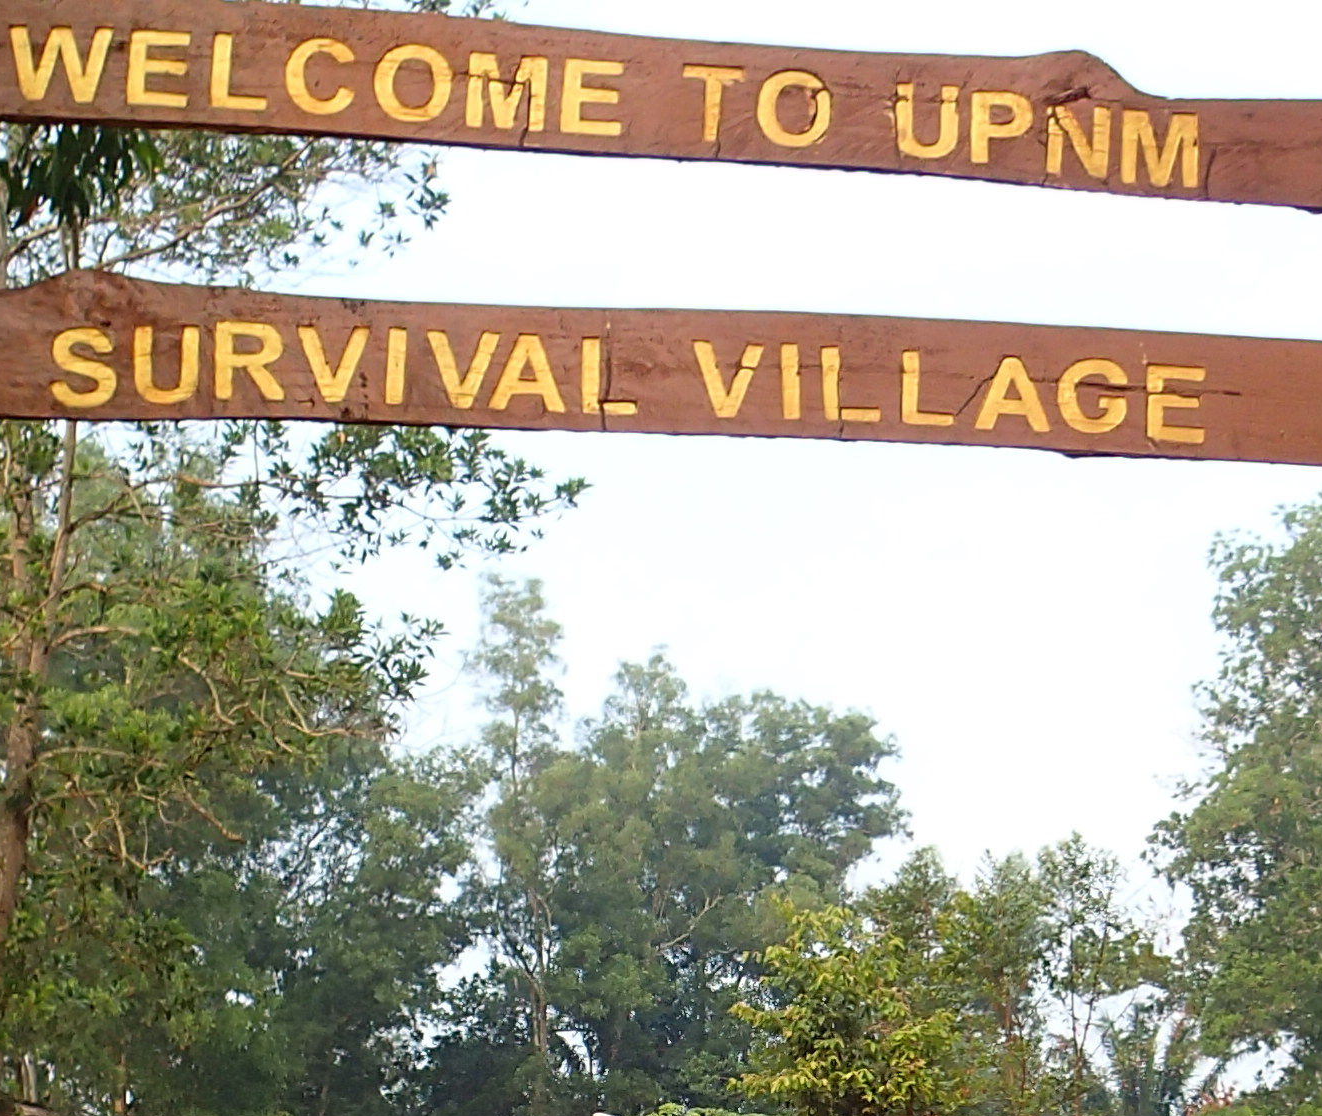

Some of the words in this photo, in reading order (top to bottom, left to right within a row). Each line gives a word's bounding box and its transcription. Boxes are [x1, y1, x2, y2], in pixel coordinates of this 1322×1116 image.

[10, 26, 626, 136] WELCOME
[681, 65, 834, 148] TO
[895, 82, 1200, 188] UPNM
[51, 322, 638, 416] SURVIVAL
[692, 340, 1206, 444] VILLAGE
